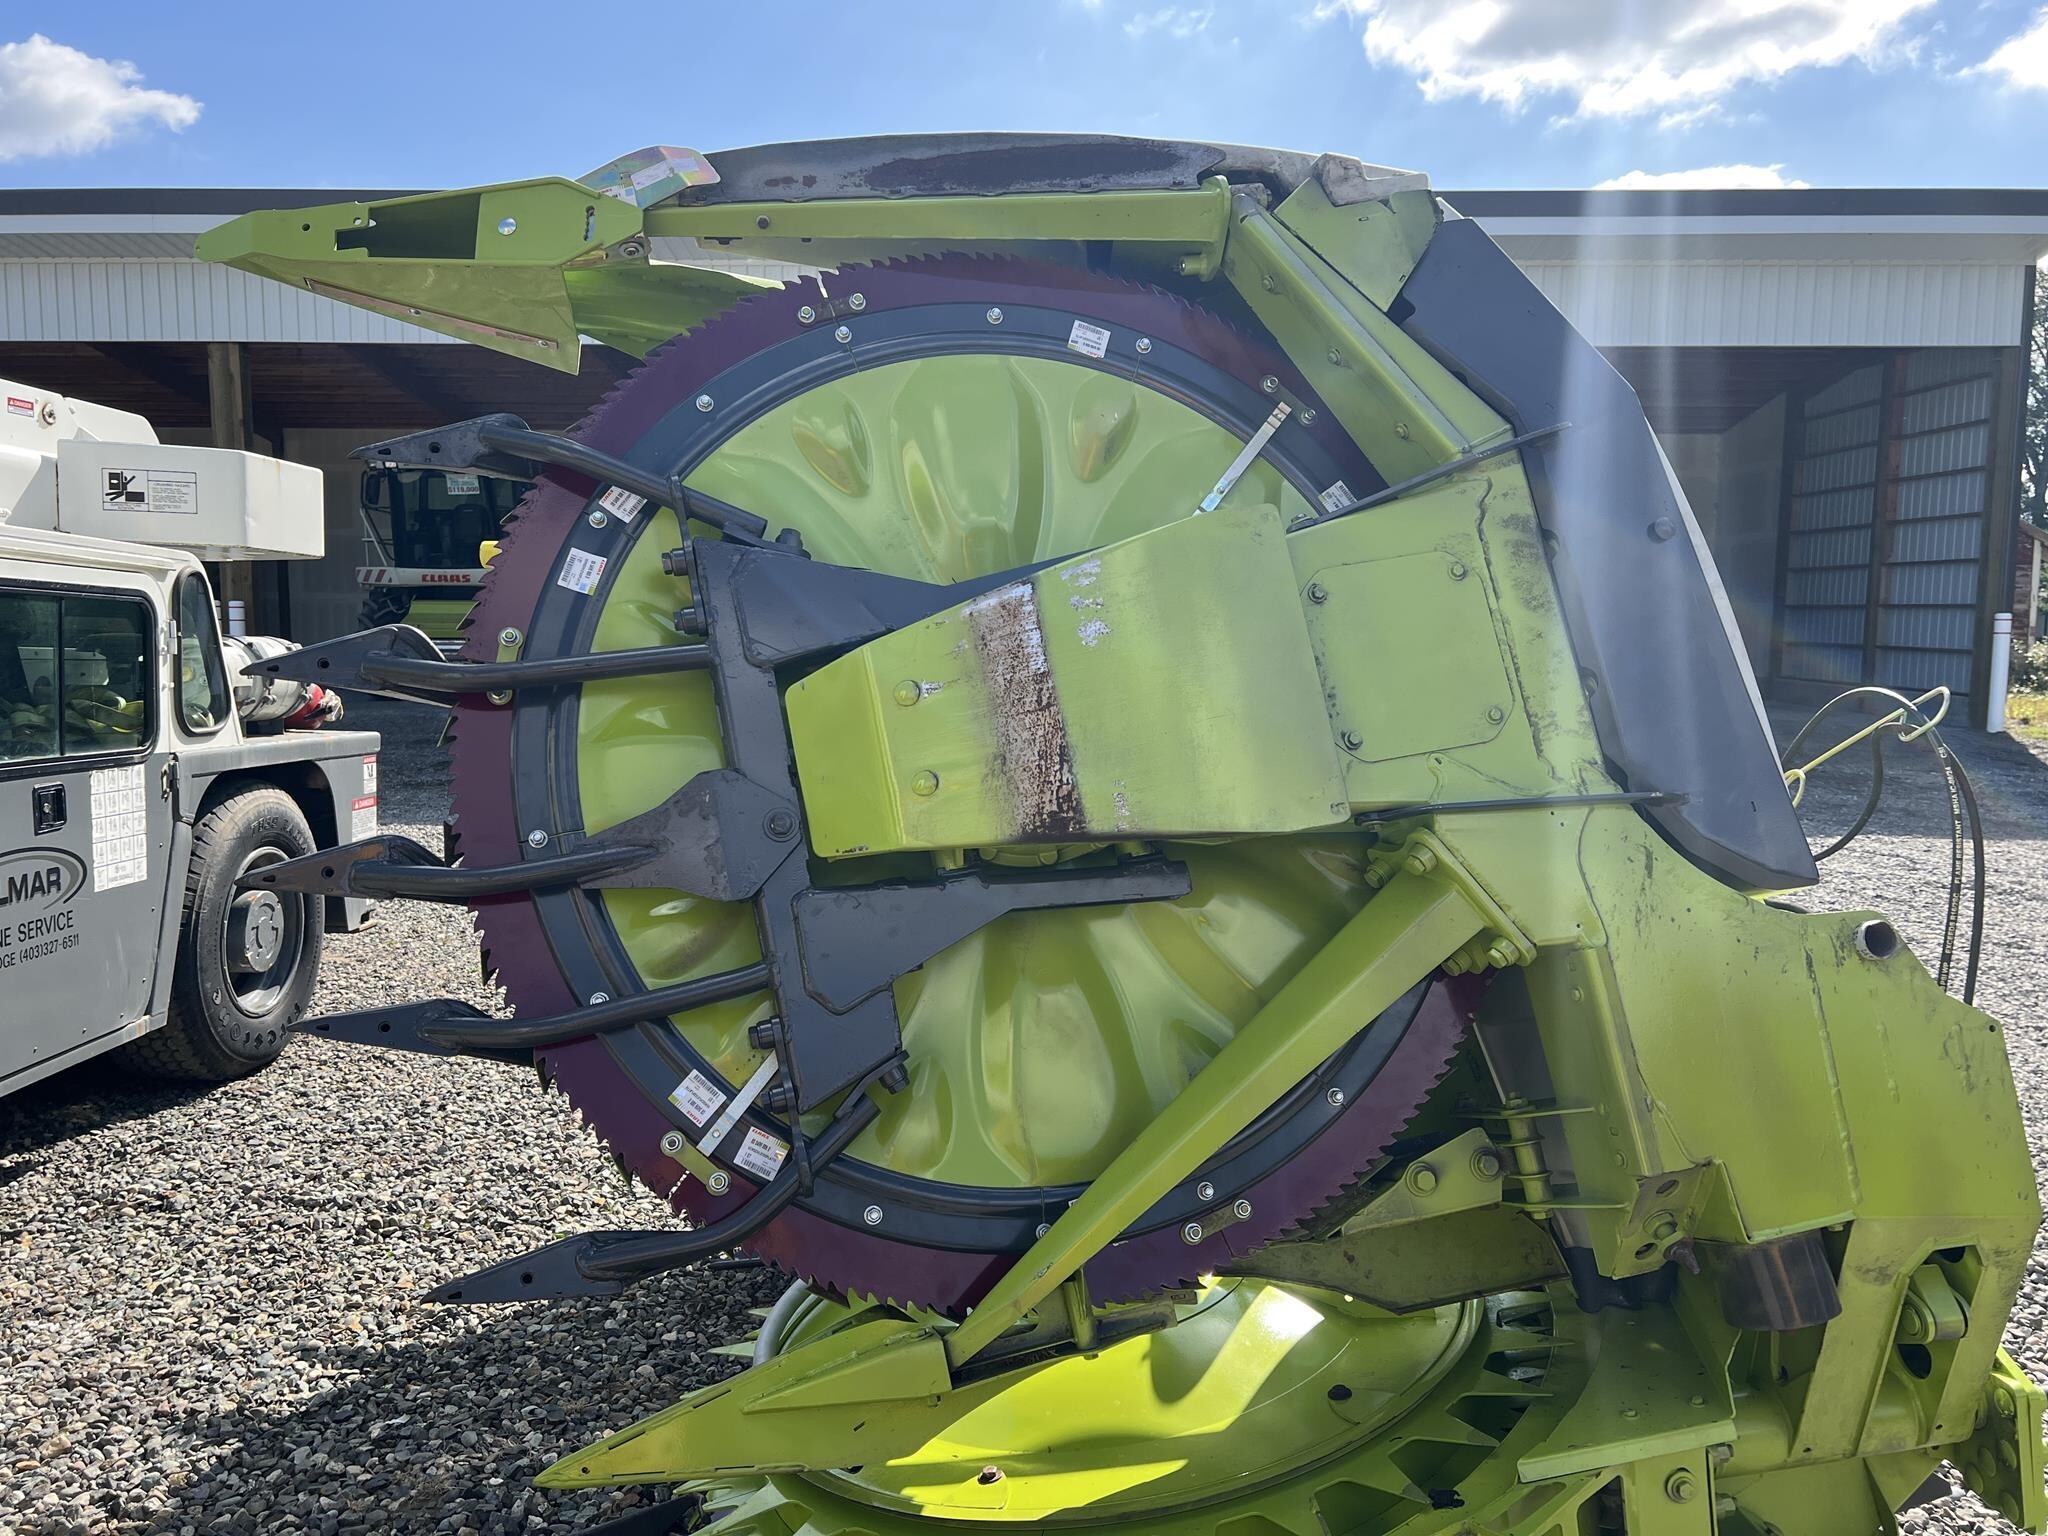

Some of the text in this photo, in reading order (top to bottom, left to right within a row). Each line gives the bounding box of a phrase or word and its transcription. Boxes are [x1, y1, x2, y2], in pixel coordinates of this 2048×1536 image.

[421, 574, 471, 583] CLAAS
[1951, 793, 1960, 815] MSHA
[1954, 820, 1963, 858] RESISTANT
[1954, 860, 1962, 884] FLAME
[17, 910, 74, 943] SERVICE
[1945, 921, 1957, 954] EXCEEDS
[19, 933, 80, 964] (403)327-6511
